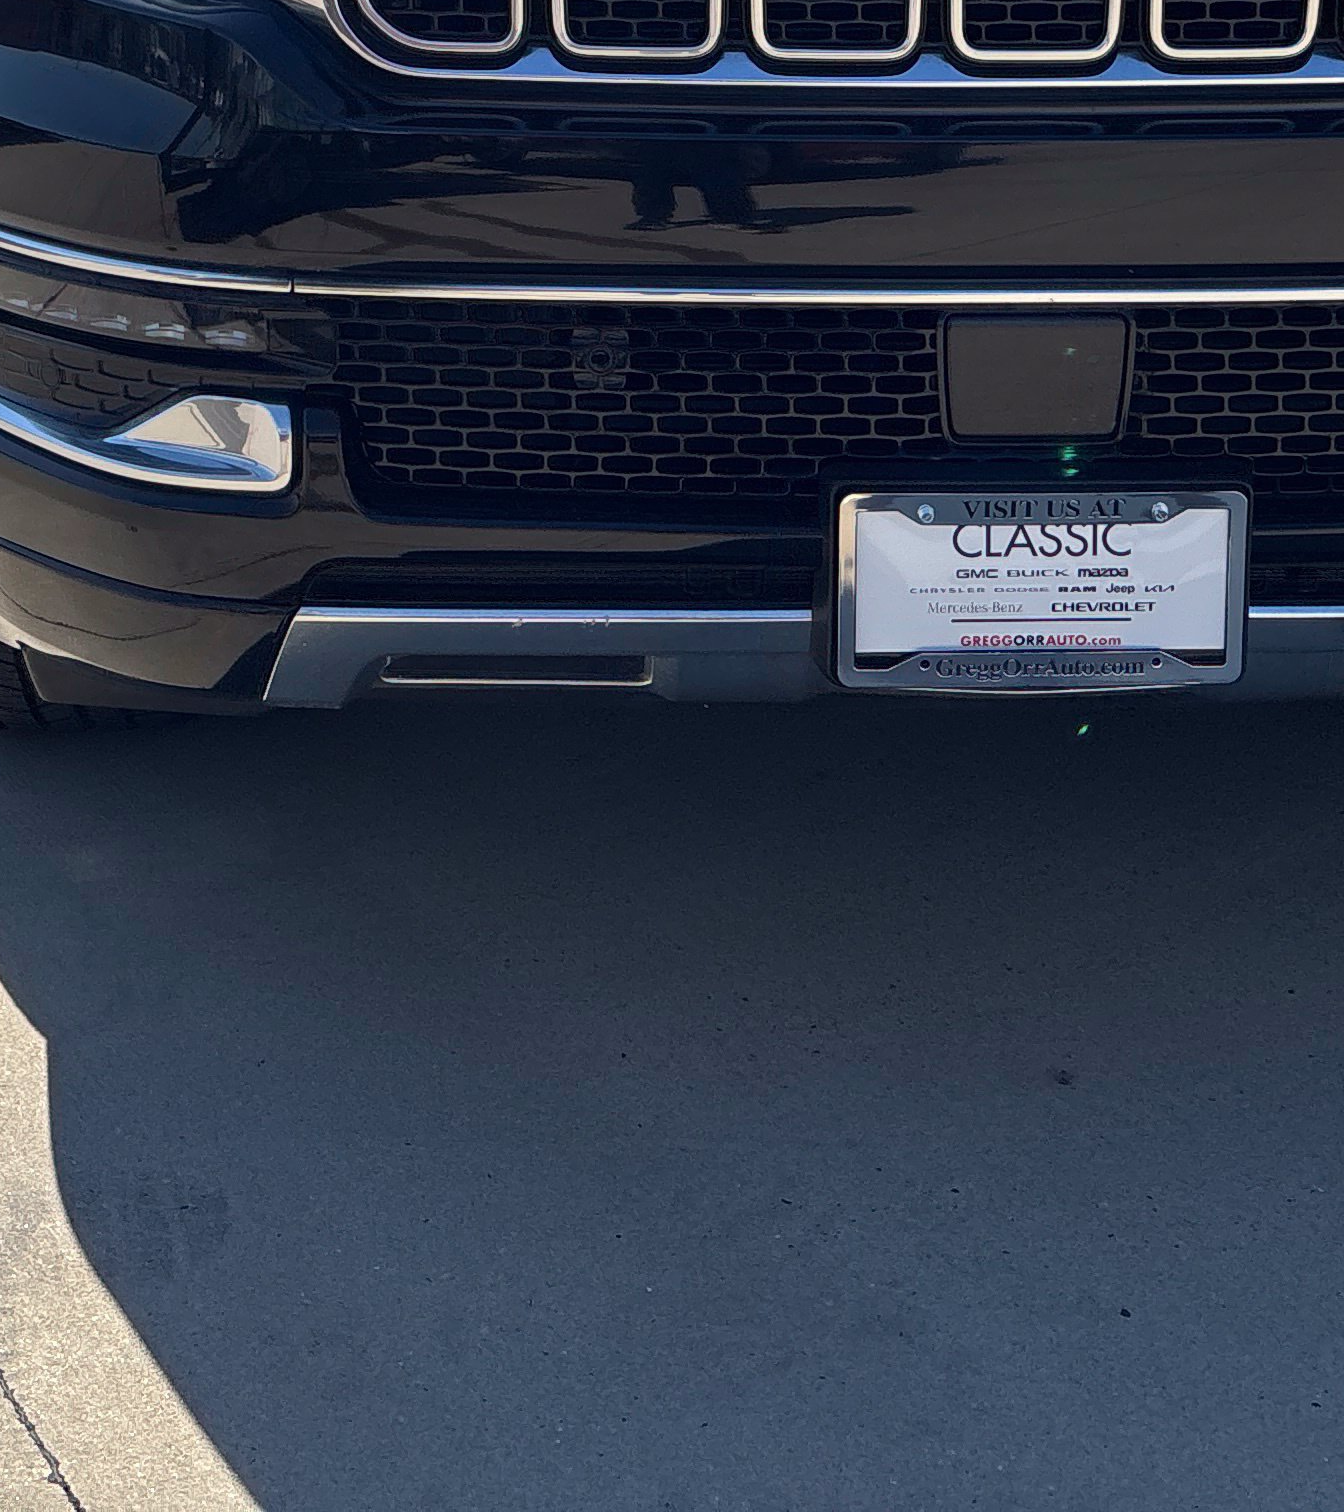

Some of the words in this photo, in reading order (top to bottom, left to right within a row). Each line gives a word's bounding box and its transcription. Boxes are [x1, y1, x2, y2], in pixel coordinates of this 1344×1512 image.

[962, 499, 1039, 521] VISIT
[1047, 499, 1081, 520] US
[1087, 498, 1127, 519] AT
[952, 523, 1132, 558] CLASSIC
[956, 568, 999, 579] GMC
[1007, 568, 1071, 578] BUICK
[909, 586, 986, 594] CHRYSLER
[1058, 585, 1097, 593] RAM
[1105, 583, 1136, 595] Jeep
[927, 601, 1024, 614] Mercedes-Benz
[1051, 601, 1157, 613] CHEVROLET
[960, 634, 1122, 647] GREGGORRAUTO.com
[935, 658, 1145, 682] GreggOrrAuto.com
